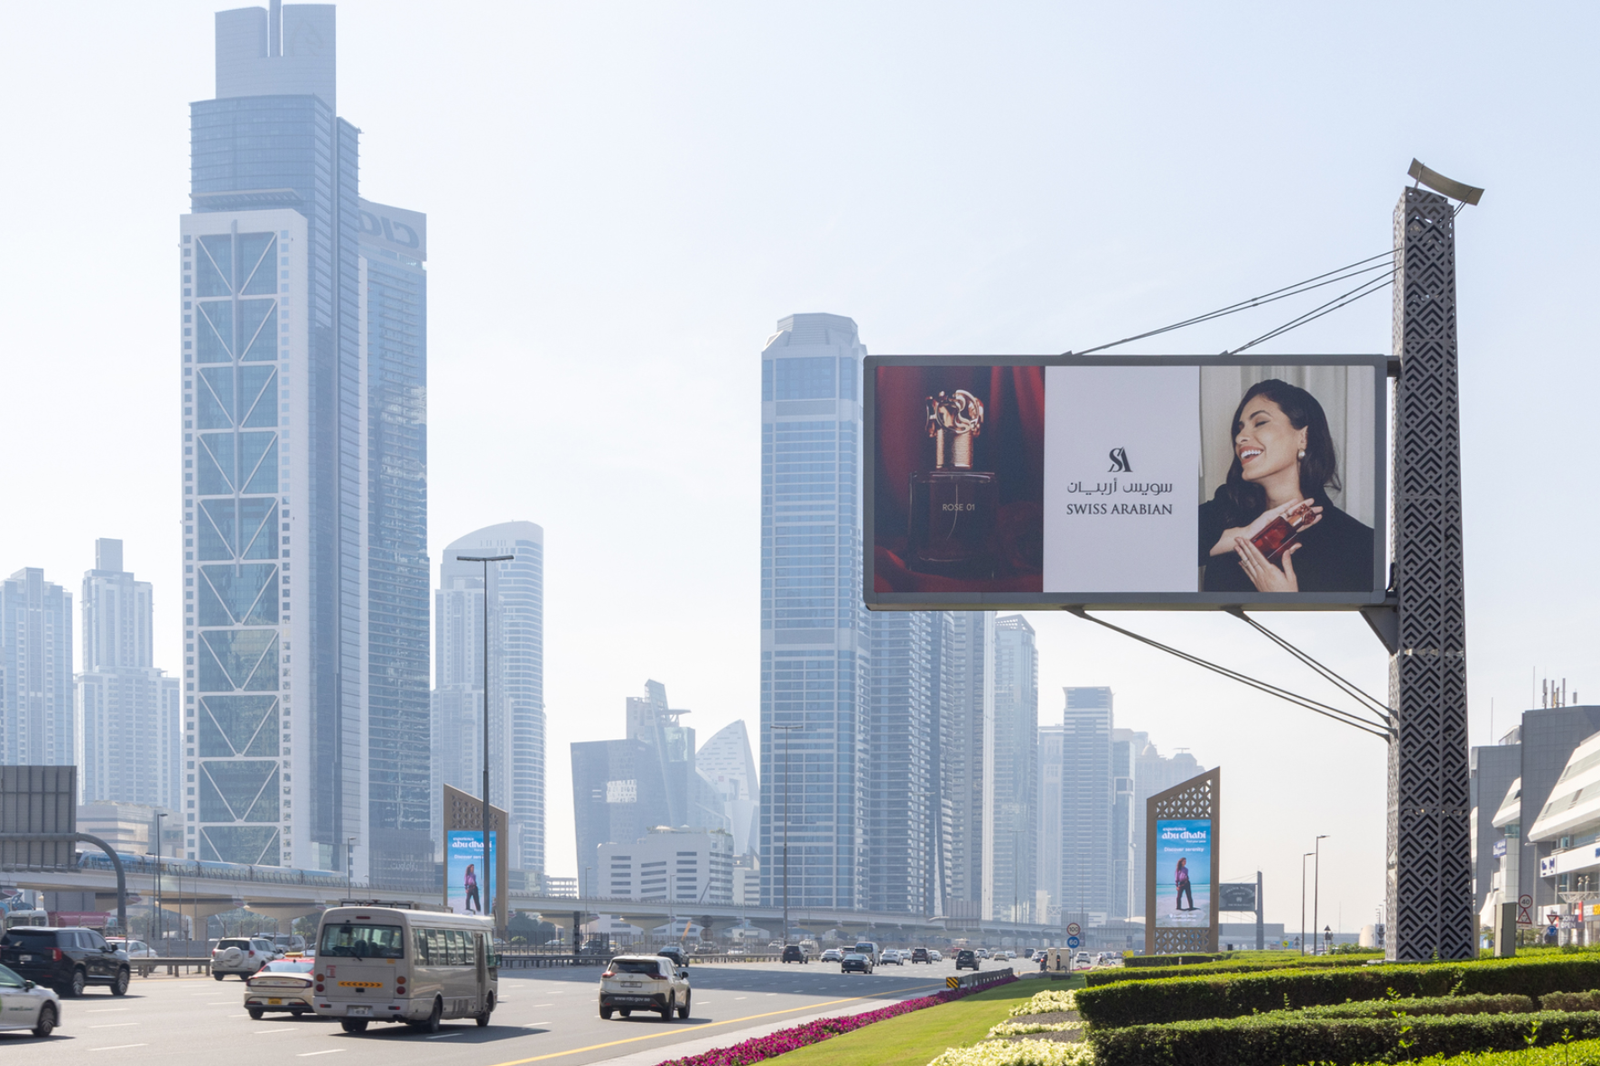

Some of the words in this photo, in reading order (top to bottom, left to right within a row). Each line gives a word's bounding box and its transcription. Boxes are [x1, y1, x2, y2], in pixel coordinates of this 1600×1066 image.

[1123, 482, 1173, 496] سويس
[942, 503, 964, 512] ROSE
[966, 503, 976, 512] 01
[1066, 503, 1107, 515] SWISS
[1110, 503, 1173, 515] ARABIAN
[1162, 831, 1179, 839] abu
[1180, 830, 1206, 839] dhabi
[452, 840, 467, 848] abu
